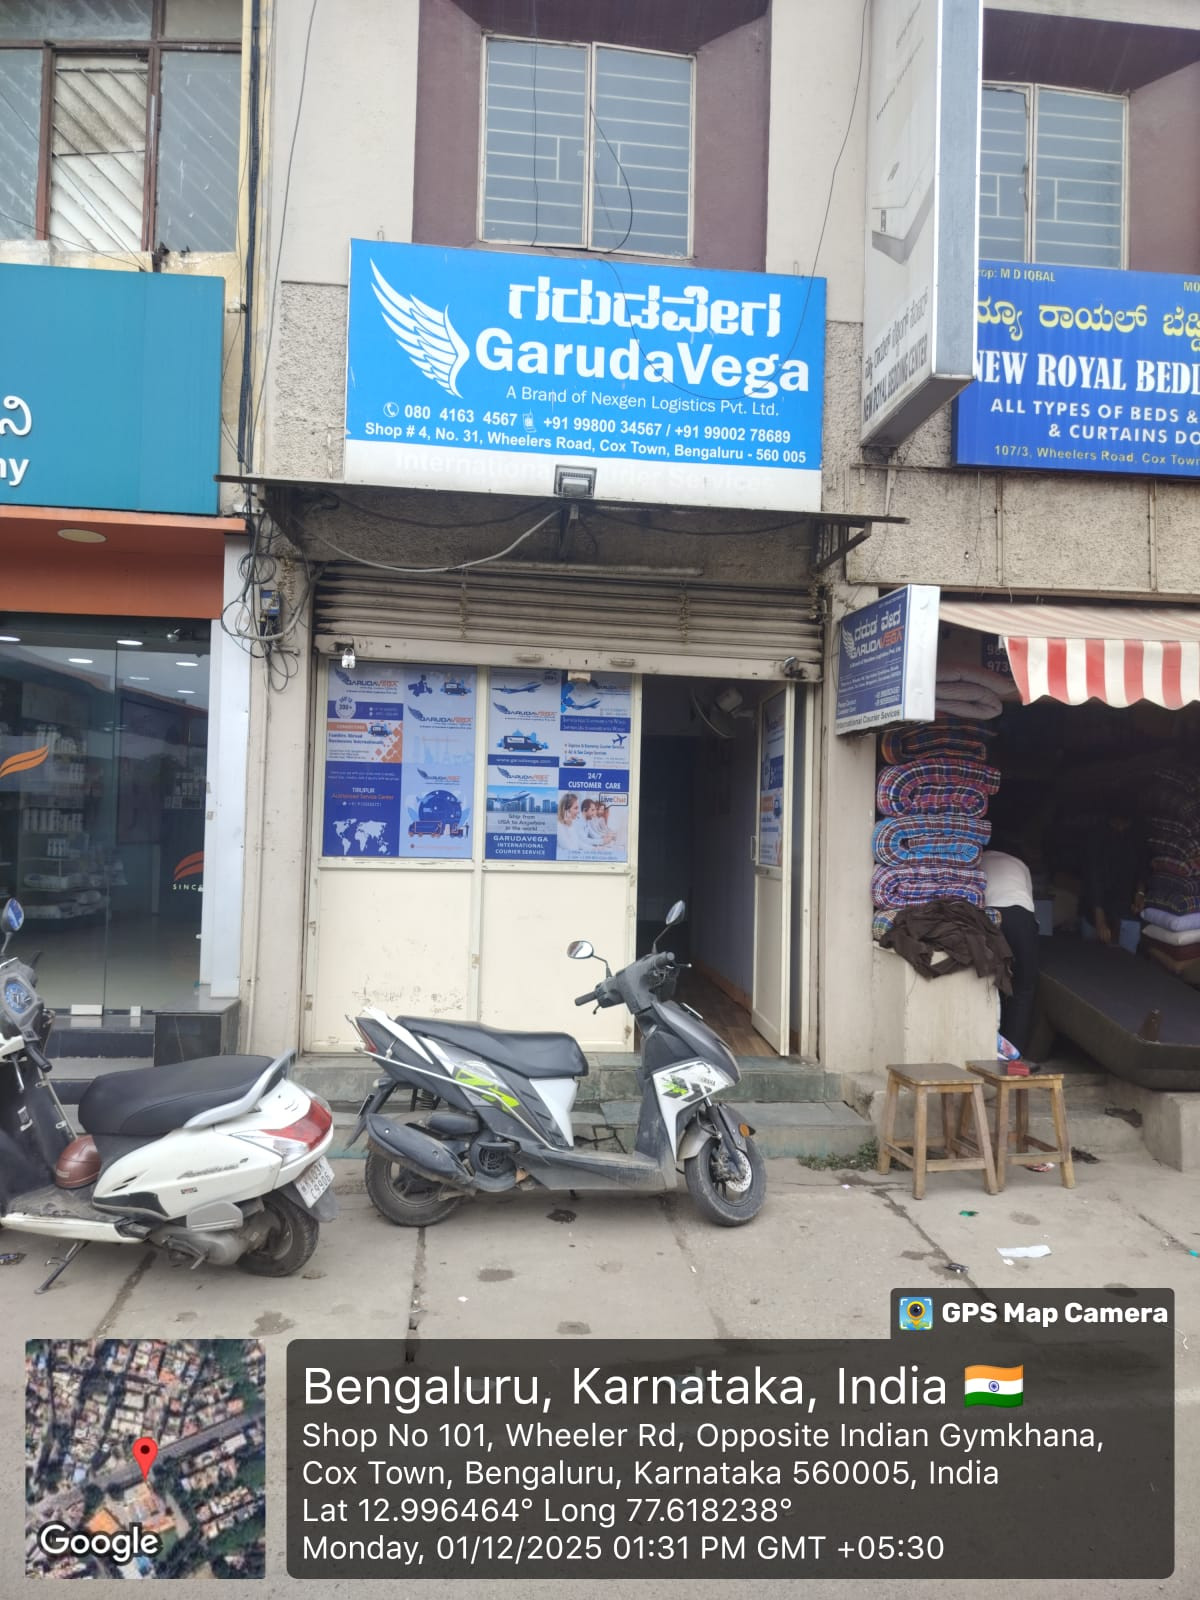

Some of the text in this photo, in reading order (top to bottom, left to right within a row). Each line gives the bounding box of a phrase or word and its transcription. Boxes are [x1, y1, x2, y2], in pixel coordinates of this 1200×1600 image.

[1000, 268, 1010, 279] M
[1013, 269, 1021, 280] D
[1024, 270, 1056, 282] IQBAL
[1038, 303, 1148, 333] ರಾಯಲ್
[475, 327, 810, 399] GarudaVega
[974, 350, 1028, 385] NEW
[1036, 353, 1127, 391] ROYAL
[505, 385, 780, 417] A Brand of Nexgen Logistics Pvt. Ltd.
[990, 398, 1199, 425] ALL TYPES OF BEDS &
[404, 404, 791, 444] 080 4163 4567 +91 99800 34567 / +91 99002 78689
[1048, 423, 1062, 438] &
[1069, 424, 1168, 444] CURTAINS
[365, 421, 402, 439] Shop
[406, 425, 416, 437] #
[418, 426, 431, 440] 4,
[435, 428, 459, 442] No.
[463, 430, 483, 444] 31,
[487, 431, 552, 449] Wheelers
[555, 436, 596, 453] Road,
[599, 439, 627, 453] Cox
[630, 441, 671, 457] Town,
[674, 445, 744, 461] Bengaluru
[755, 448, 779, 462] 560
[782, 449, 807, 464] 005
[1037, 447, 1097, 461] Wheelers
[1141, 452, 1166, 464] Cox
[568, 781, 621, 790] CUSTOMER CARE
[172, 883, 203, 892] SINC
